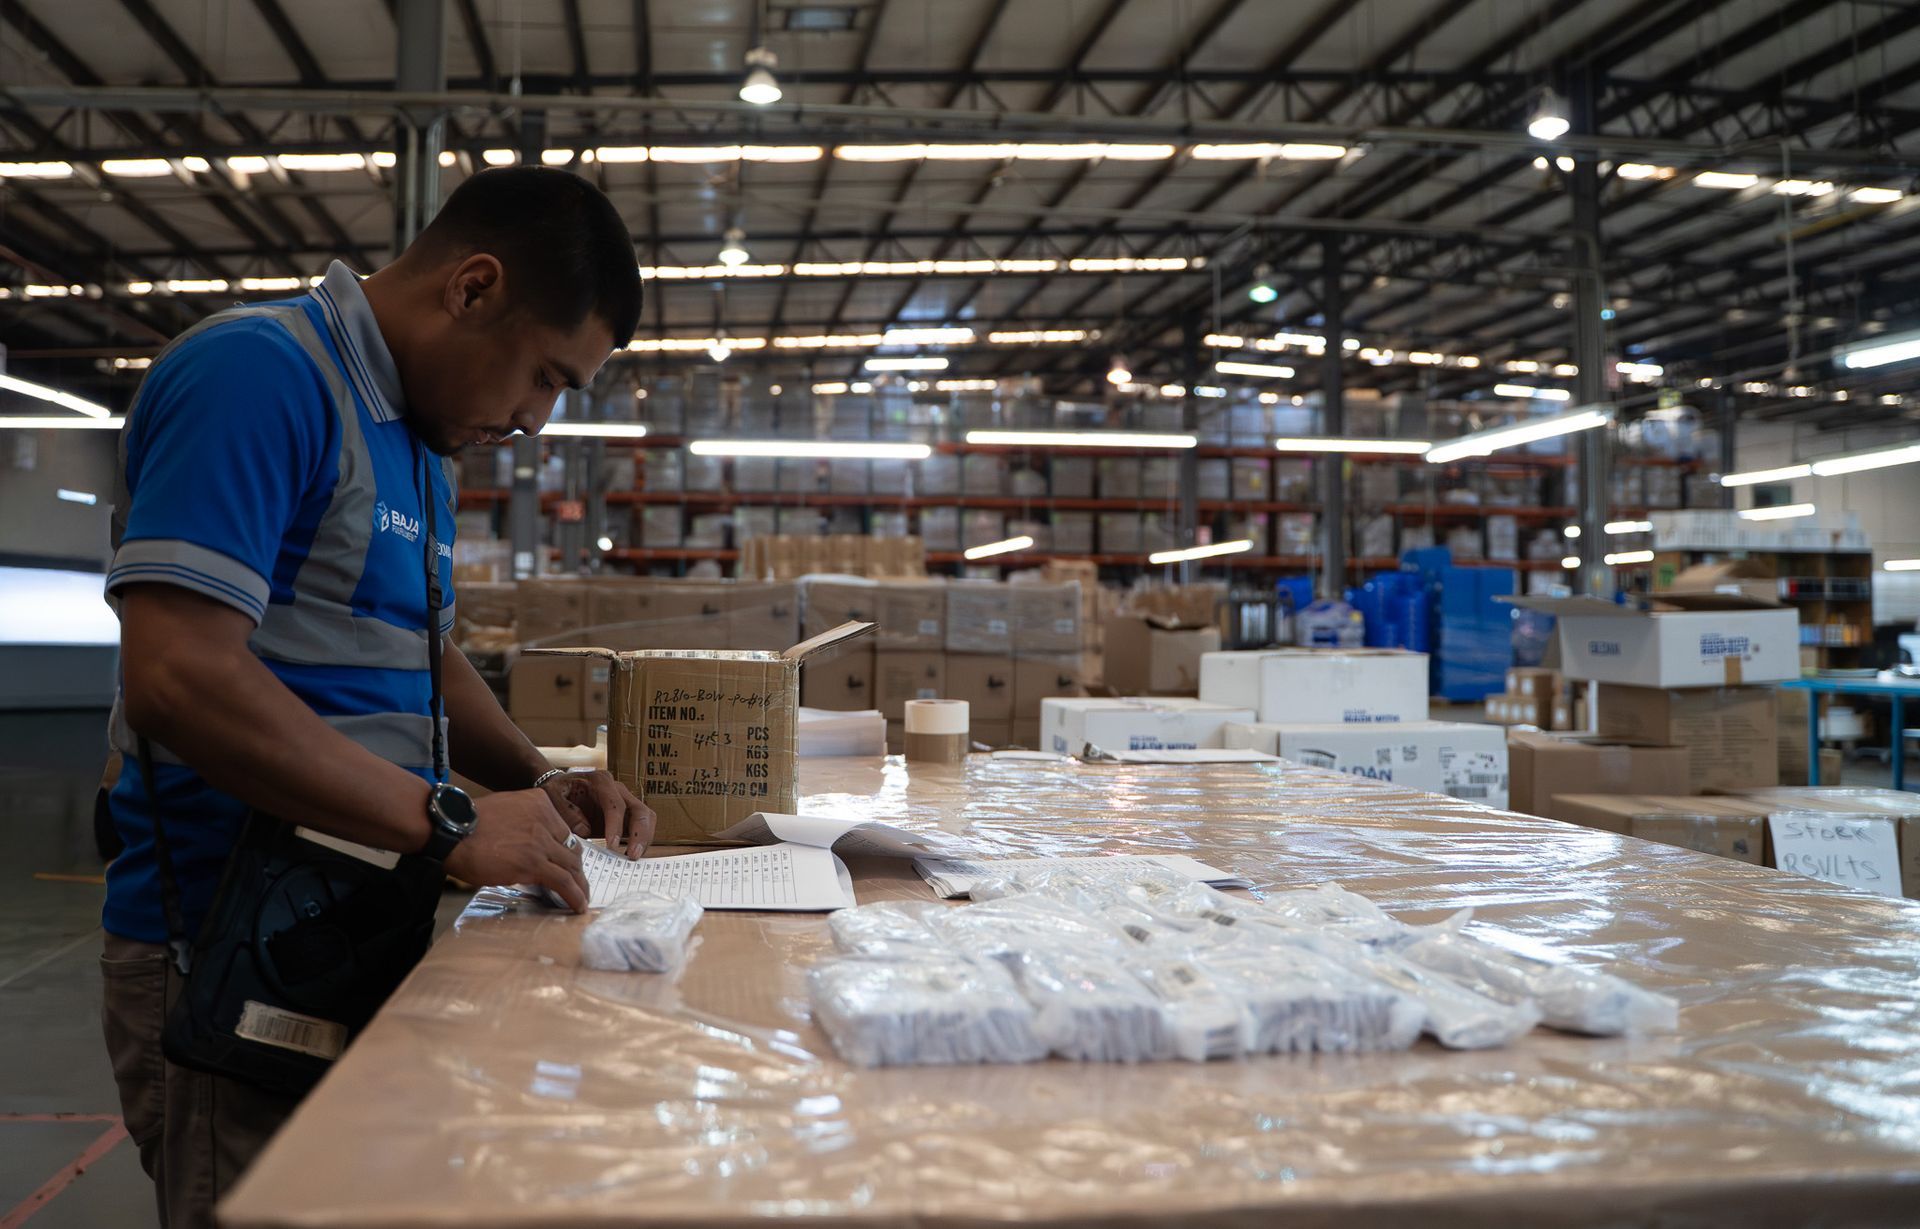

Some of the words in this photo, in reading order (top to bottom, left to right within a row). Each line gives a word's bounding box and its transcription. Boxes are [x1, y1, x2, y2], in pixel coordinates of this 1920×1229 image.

[391, 509, 419, 535] BAJA
[648, 706, 677, 720] ITEM
[680, 706, 705, 721] NO.:
[648, 724, 672, 739] QTY:
[747, 726, 769, 741] PCS
[647, 743, 678, 757] N.W.:
[746, 745, 769, 759] KGS
[647, 761, 677, 776] G.W.:
[746, 763, 769, 778] KGS
[646, 780, 683, 795] MEAS:
[750, 782, 768, 796] CM
